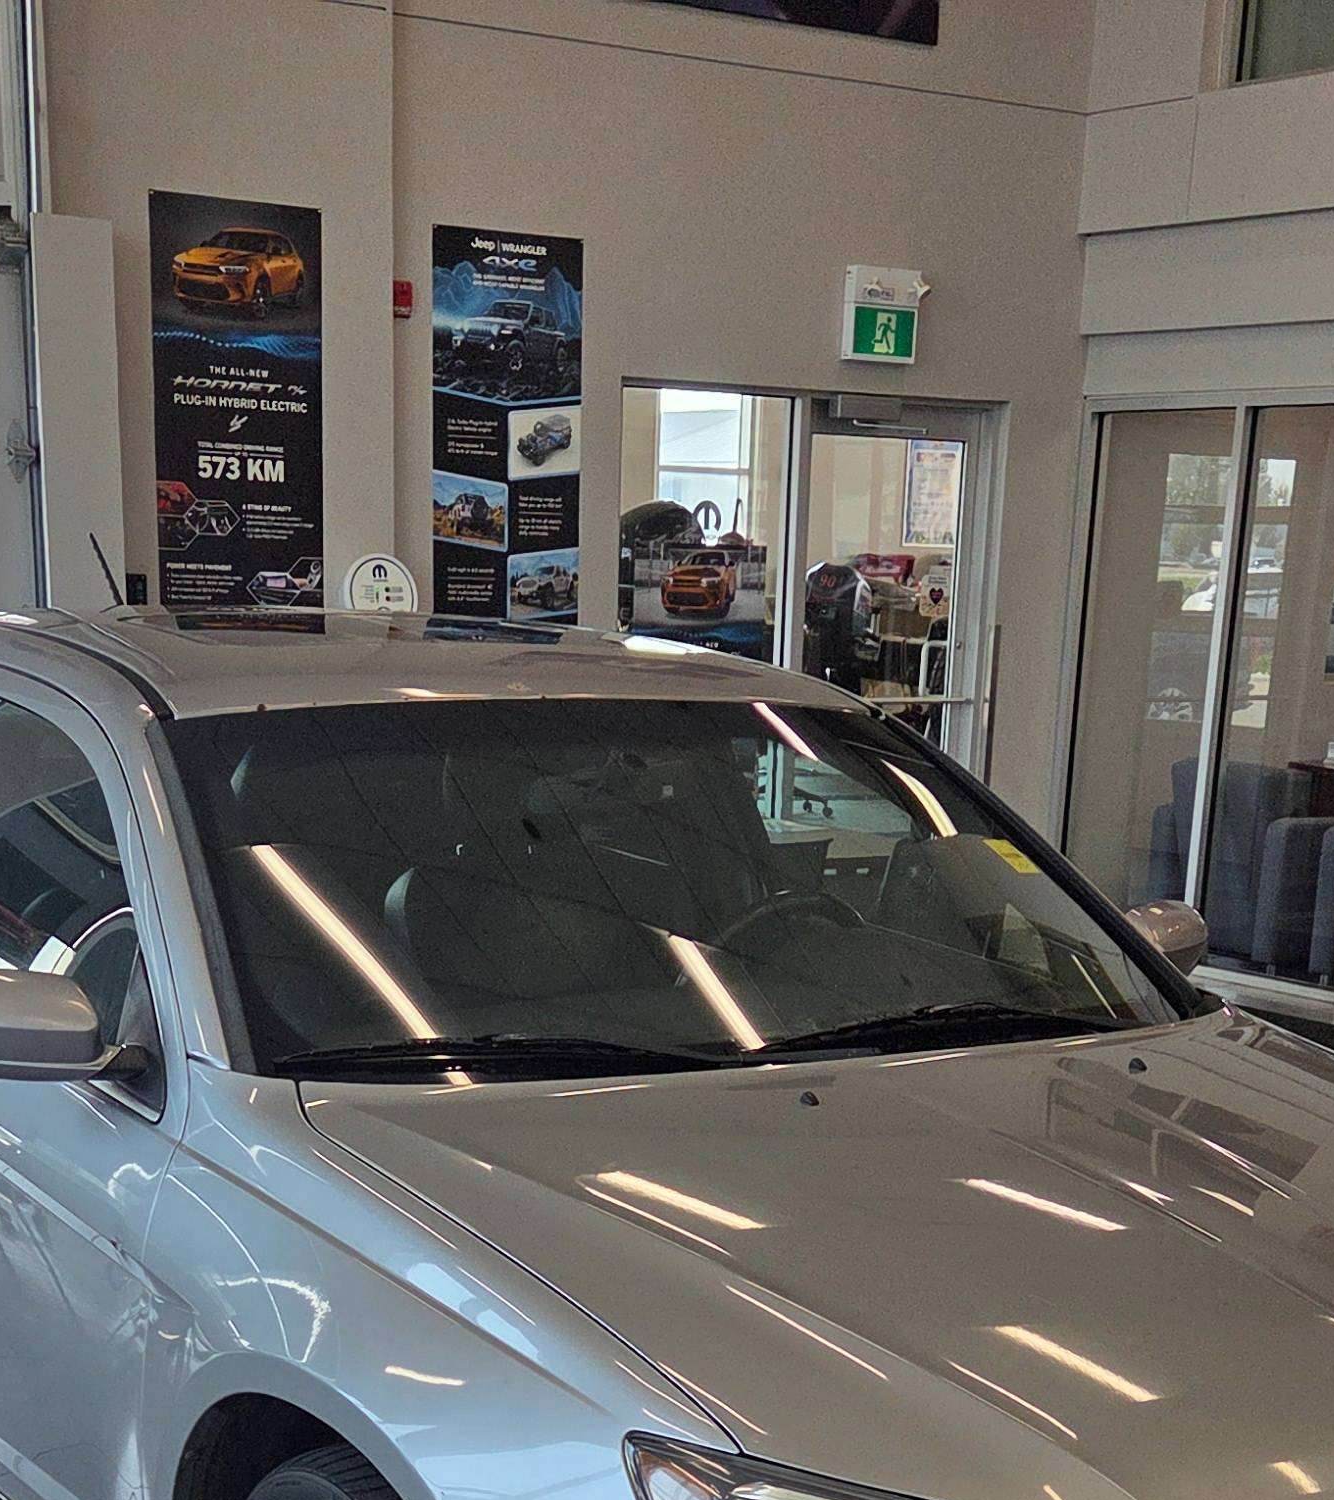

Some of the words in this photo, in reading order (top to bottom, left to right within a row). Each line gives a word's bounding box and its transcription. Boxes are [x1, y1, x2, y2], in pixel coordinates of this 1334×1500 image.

[470, 236, 496, 252] Jeep
[501, 242, 547, 256] WRANGLER
[209, 365, 227, 376] THE
[230, 367, 269, 378] ALL-NEW
[172, 375, 283, 394] HORNET
[174, 393, 217, 407] PLUG-IN
[219, 396, 257, 410] HYBRID
[260, 400, 308, 413] ELECTRIC
[197, 455, 241, 480] 573
[247, 458, 285, 483] KM
